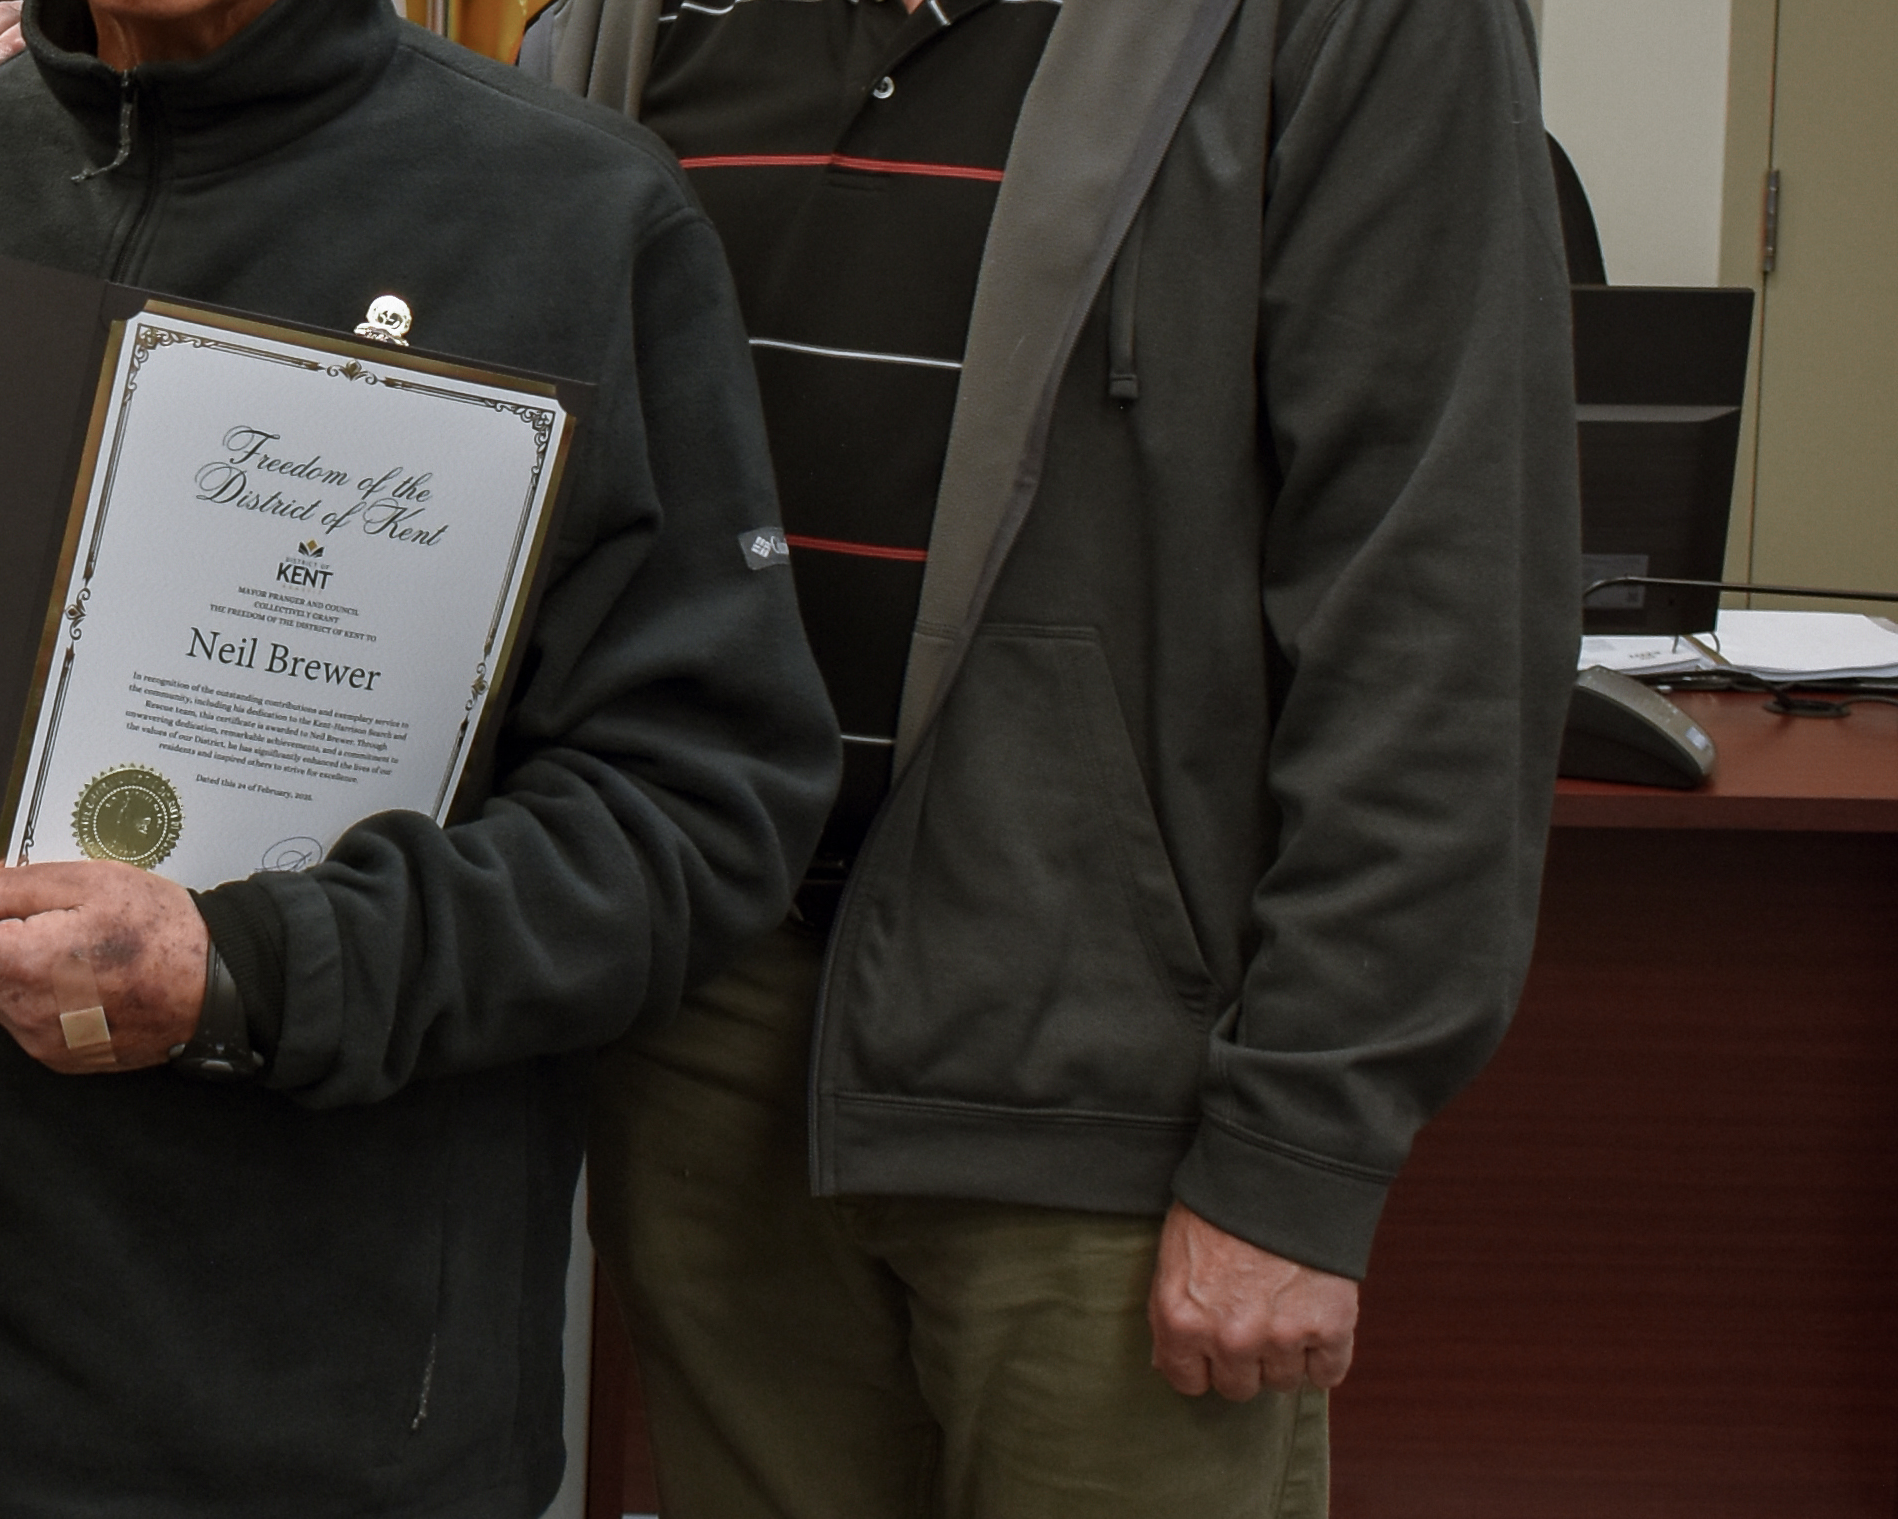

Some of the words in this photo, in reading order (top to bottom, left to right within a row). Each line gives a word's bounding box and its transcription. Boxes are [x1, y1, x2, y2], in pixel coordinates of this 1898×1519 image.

[222, 425, 352, 486] Freedom
[357, 466, 404, 502] of
[389, 472, 433, 503] the
[194, 461, 322, 521] District
[320, 500, 367, 536] of
[362, 496, 449, 546] Kent
[276, 563, 333, 589] KENT
[238, 586, 267, 597] MAYOR
[306, 600, 324, 609] AND
[325, 603, 359, 616] COUNCIL
[312, 613, 340, 623] GRANT
[210, 604, 226, 613] THE
[227, 608, 265, 621] FREEDOM
[266, 615, 278, 623] OF
[279, 618, 294, 626] THE
[296, 621, 332, 634] DISTRICT
[344, 631, 365, 640] KENT
[366, 634, 377, 642] TO
[186, 627, 257, 668] Neil
[265, 643, 381, 690] Brewer
[143, 676, 190, 690] recognition
[191, 684, 201, 692] of
[201, 686, 214, 694] the
[318, 709, 333, 717] and
[299, 717, 312, 725] the
